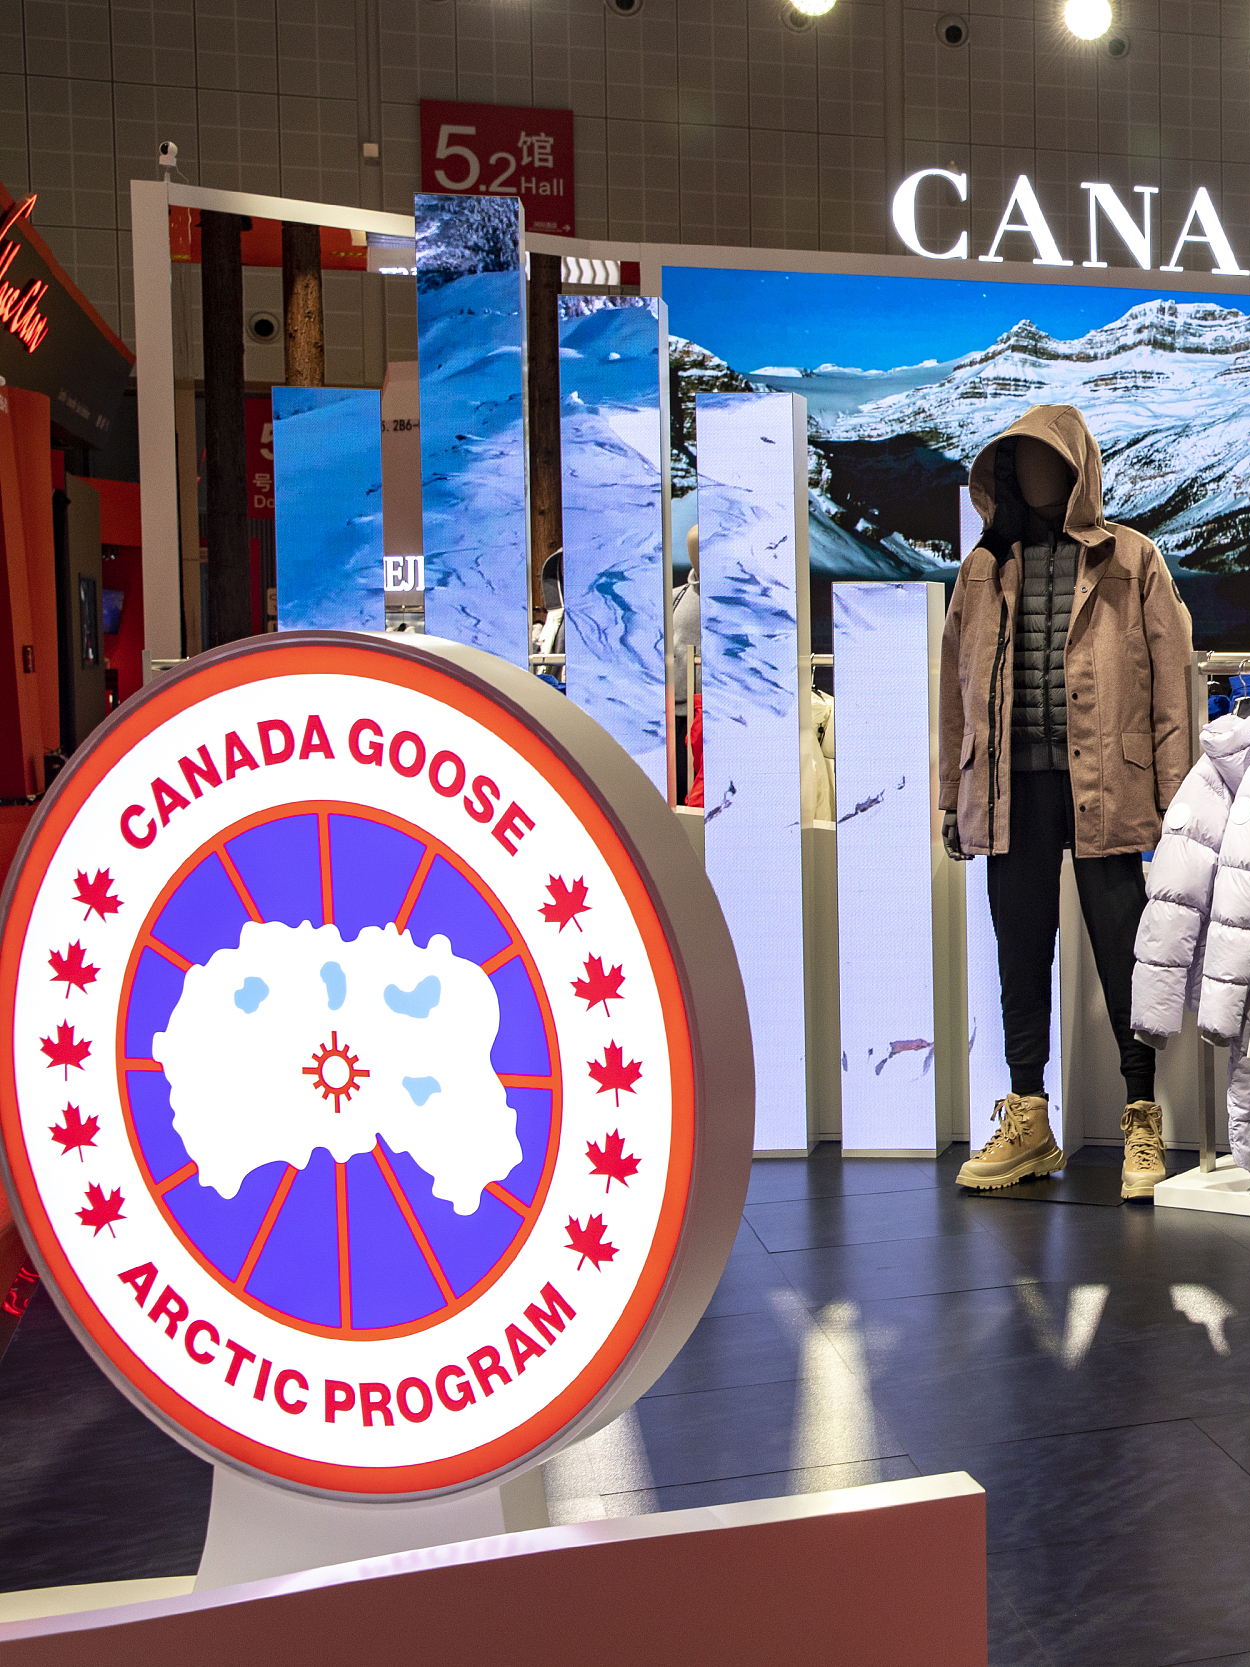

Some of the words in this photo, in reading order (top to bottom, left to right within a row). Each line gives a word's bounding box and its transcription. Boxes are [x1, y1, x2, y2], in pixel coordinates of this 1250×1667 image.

[434, 123, 517, 193] 5.2
[517, 130, 554, 168] 馆
[520, 176, 564, 196] Hall
[120, 715, 335, 849] CANADA
[348, 718, 536, 857] GOOSE
[118, 1262, 309, 1414] ARCTIC
[324, 1281, 577, 1427] PROGRAM
